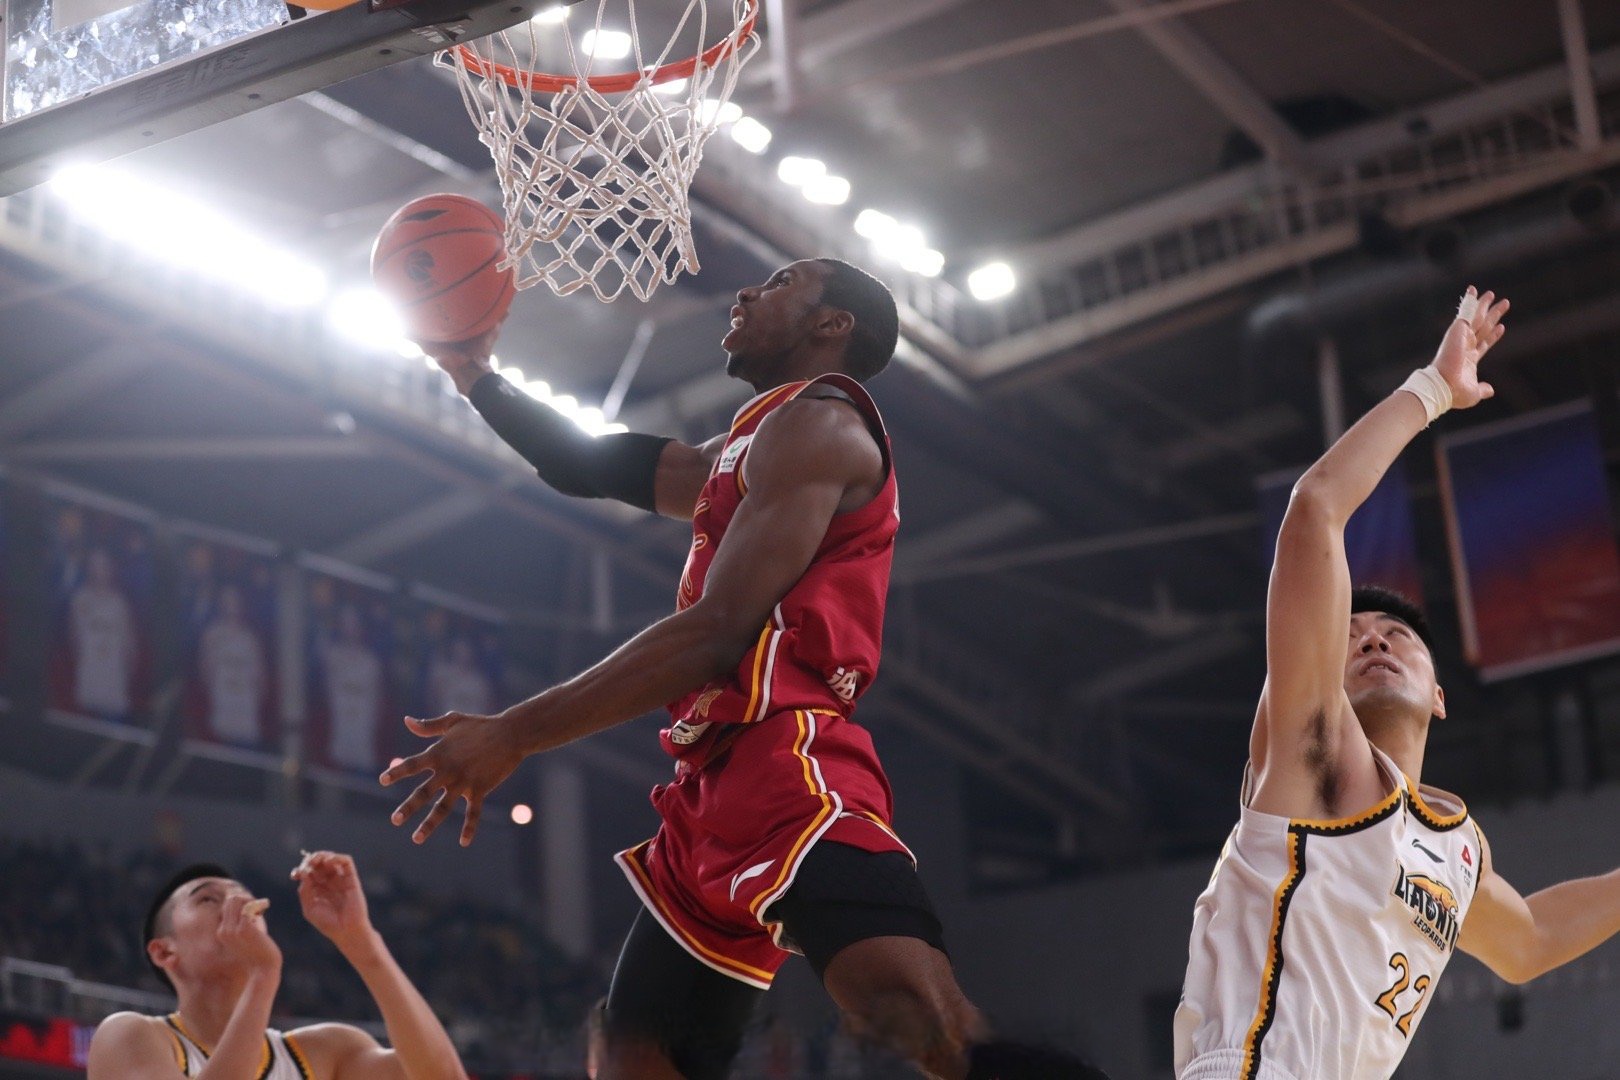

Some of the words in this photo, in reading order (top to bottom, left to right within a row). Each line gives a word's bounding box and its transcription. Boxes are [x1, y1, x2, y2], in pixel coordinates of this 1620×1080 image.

[1394, 864, 1459, 952] LIAONI
[1413, 915, 1446, 951] LEOPARDS
[1374, 952, 1430, 1038] 22
